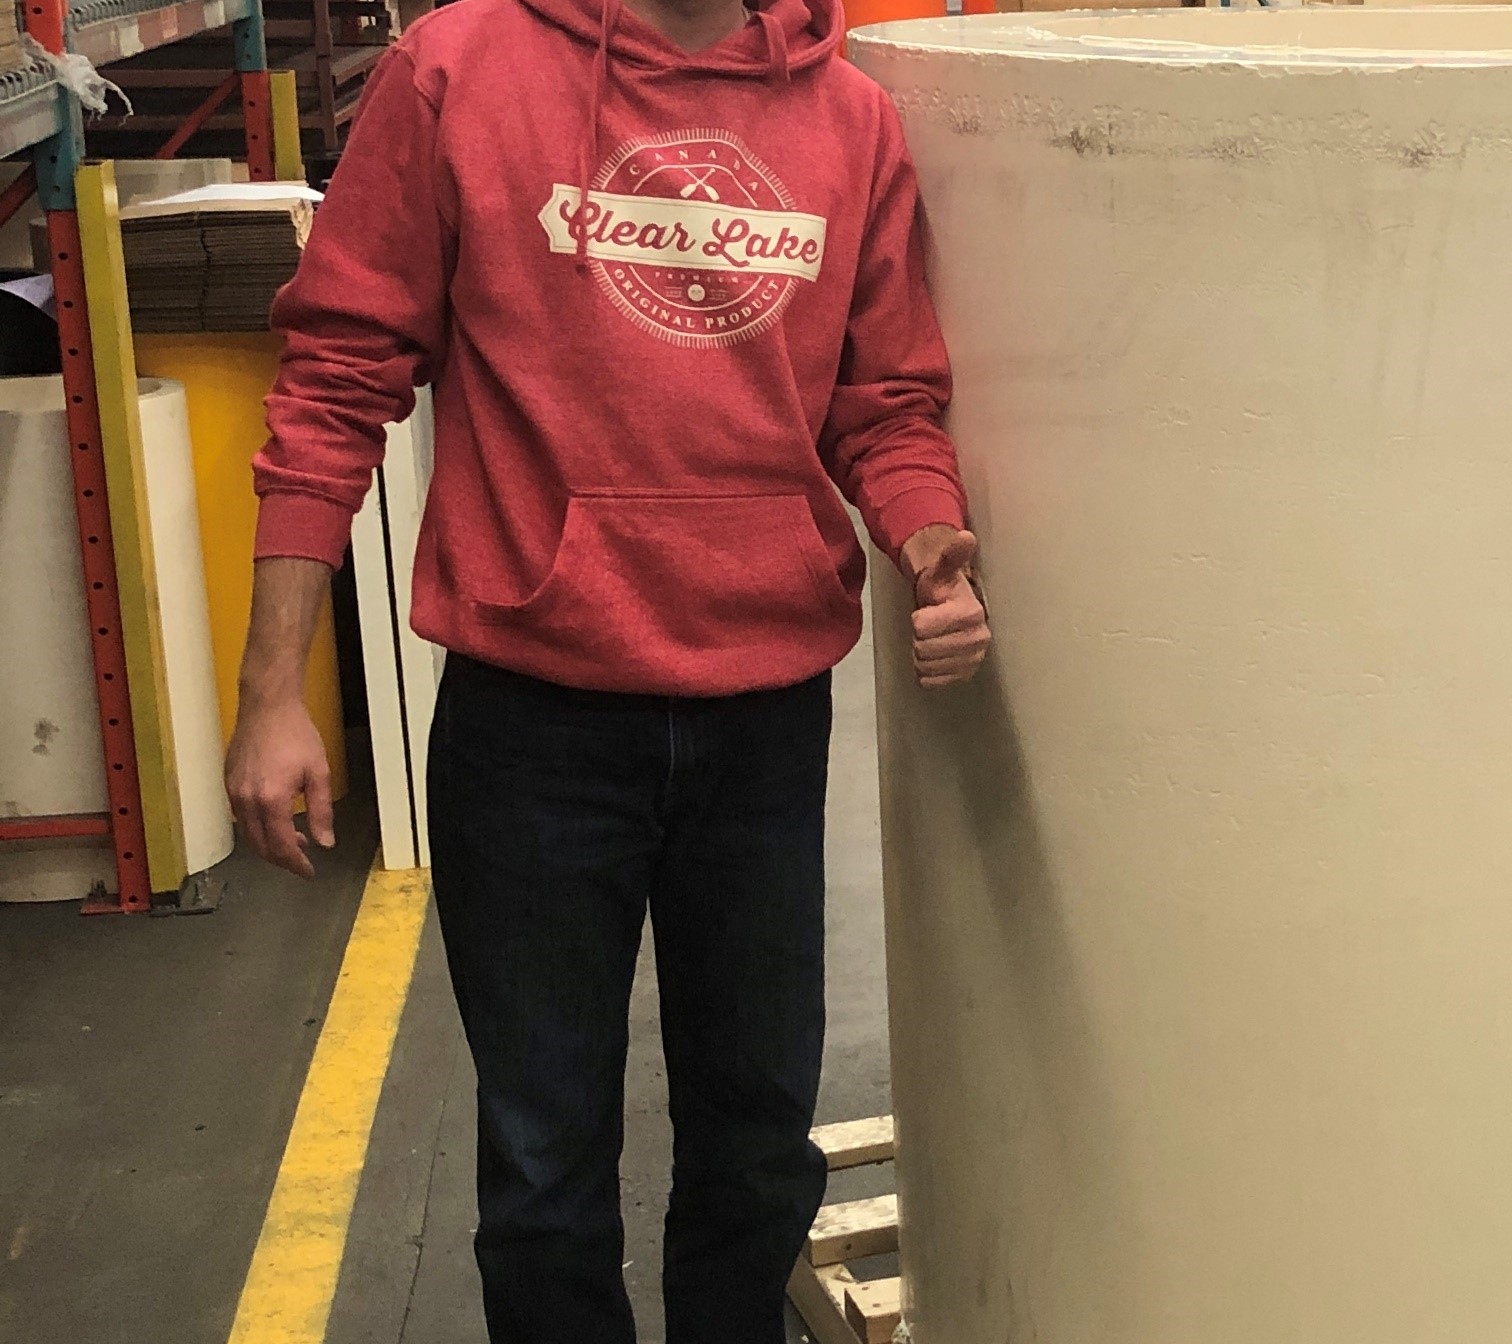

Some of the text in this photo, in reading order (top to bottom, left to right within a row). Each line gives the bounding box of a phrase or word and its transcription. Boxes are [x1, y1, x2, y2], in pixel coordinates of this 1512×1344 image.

[630, 149, 759, 192] CANADA
[559, 199, 821, 268] Clear Lake
[614, 268, 780, 329] ORIGINAL PRODUCT
